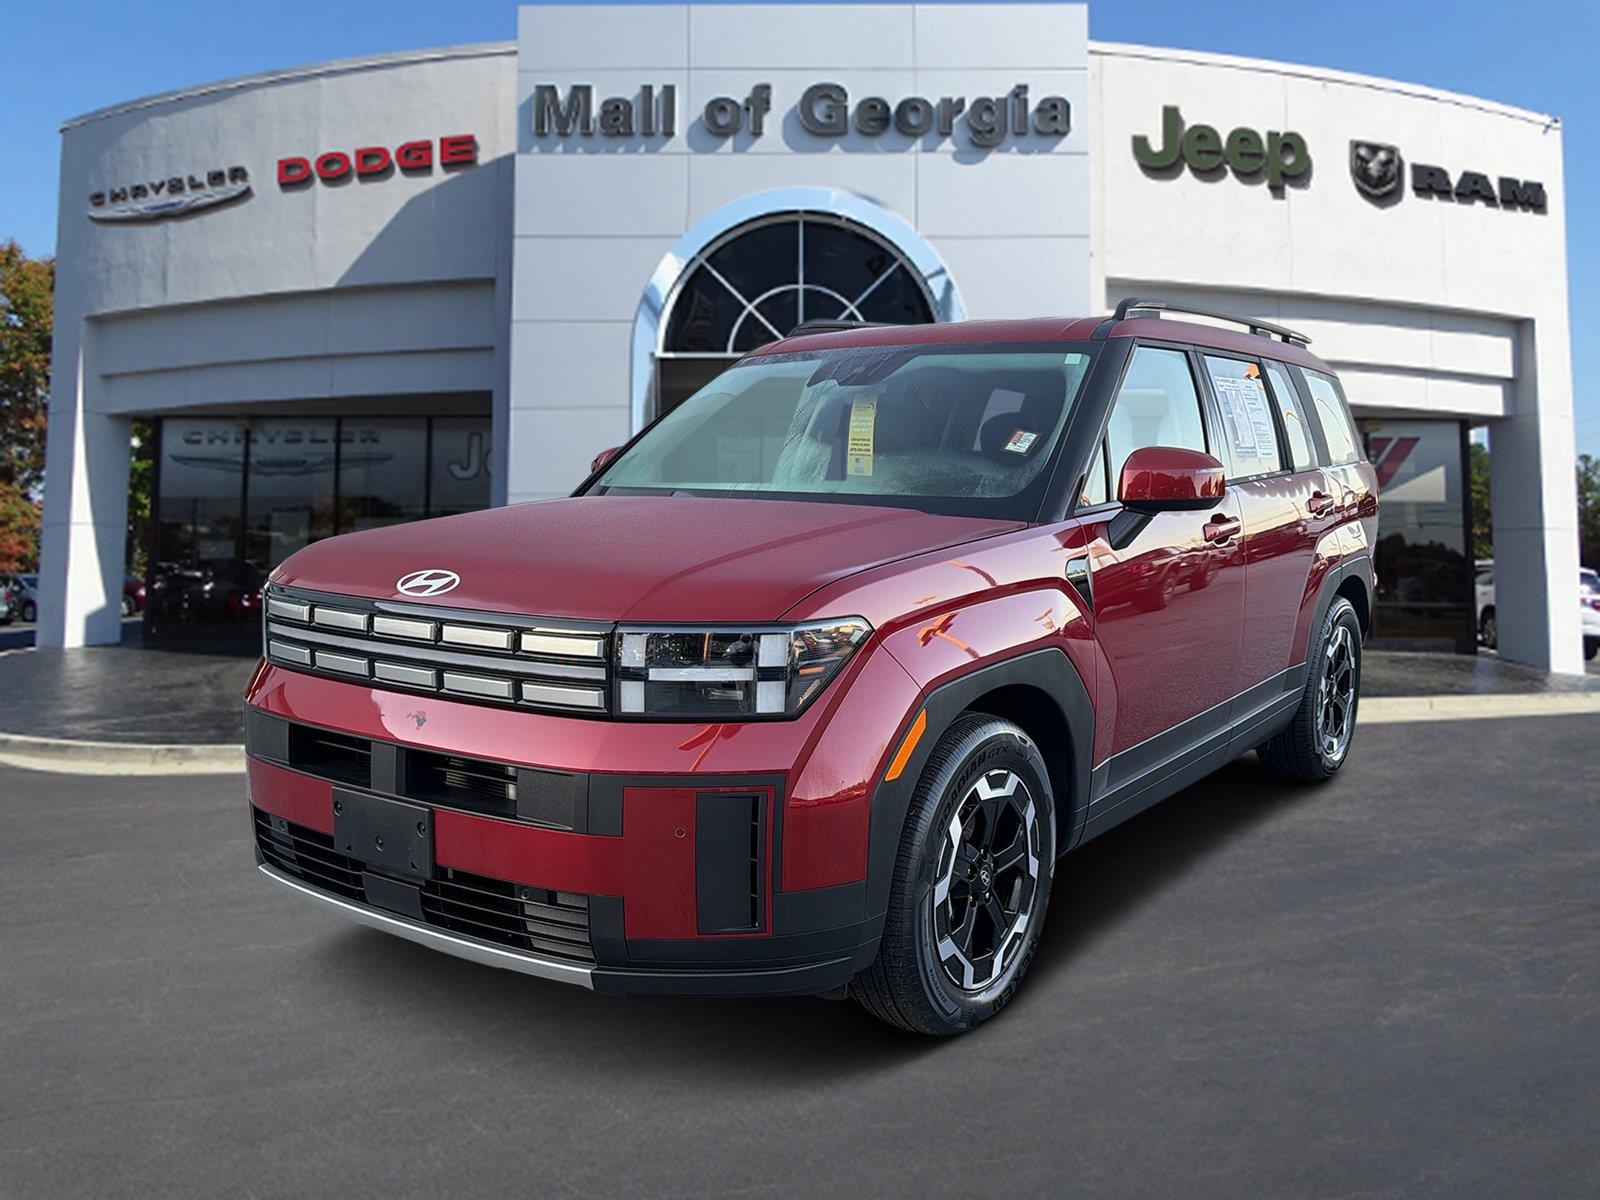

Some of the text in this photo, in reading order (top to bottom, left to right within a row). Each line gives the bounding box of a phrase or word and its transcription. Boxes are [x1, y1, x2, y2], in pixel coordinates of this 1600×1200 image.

[533, 83, 1073, 149] Mall of Georgia
[277, 134, 480, 190] DODGE
[1132, 105, 1310, 197] Jeep
[89, 166, 249, 207] CHRYSLER
[1410, 162, 1548, 215] RAM
[448, 431, 492, 481] J
